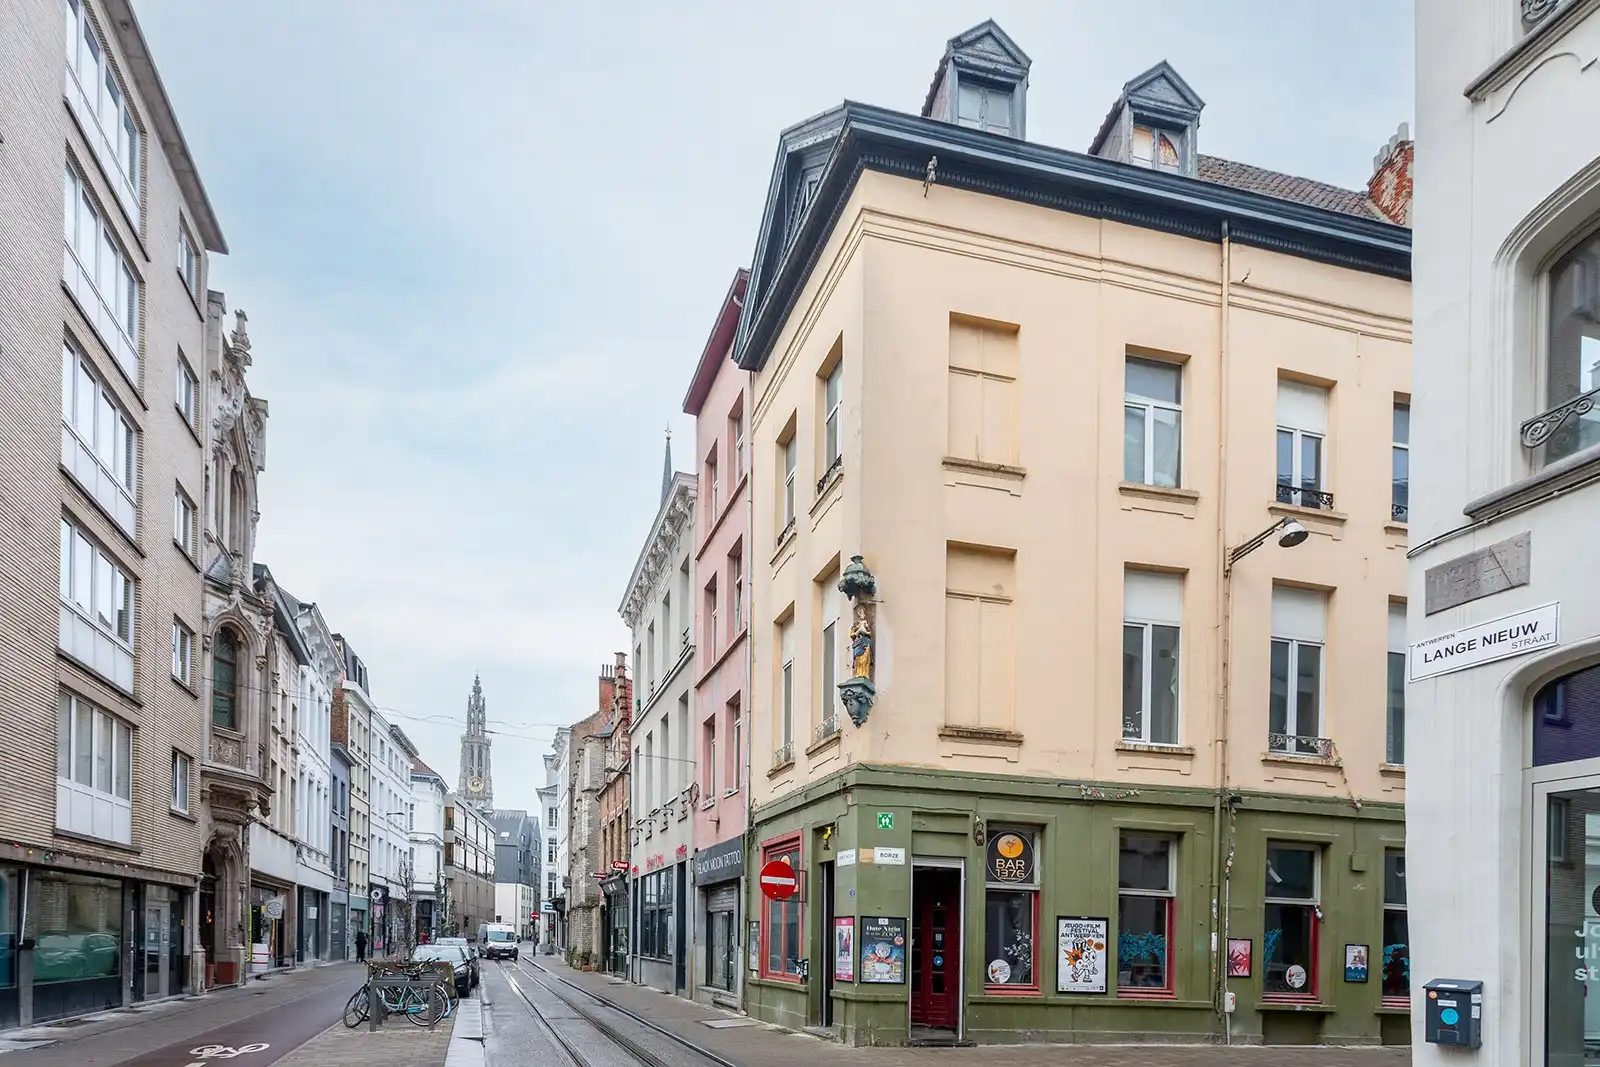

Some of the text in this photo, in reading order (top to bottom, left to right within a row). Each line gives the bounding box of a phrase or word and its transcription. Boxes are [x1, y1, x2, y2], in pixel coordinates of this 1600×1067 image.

[1416, 633, 1455, 648] ANTWERPEN
[1424, 621, 1538, 663] LANGE NIEUW
[1511, 633, 1551, 649] STRAAT
[698, 850, 741, 874] BLACK MOON TATTOO
[996, 858, 1025, 870] BAR
[996, 869, 1025, 878] 1376
[1575, 943, 1600, 959] ul
